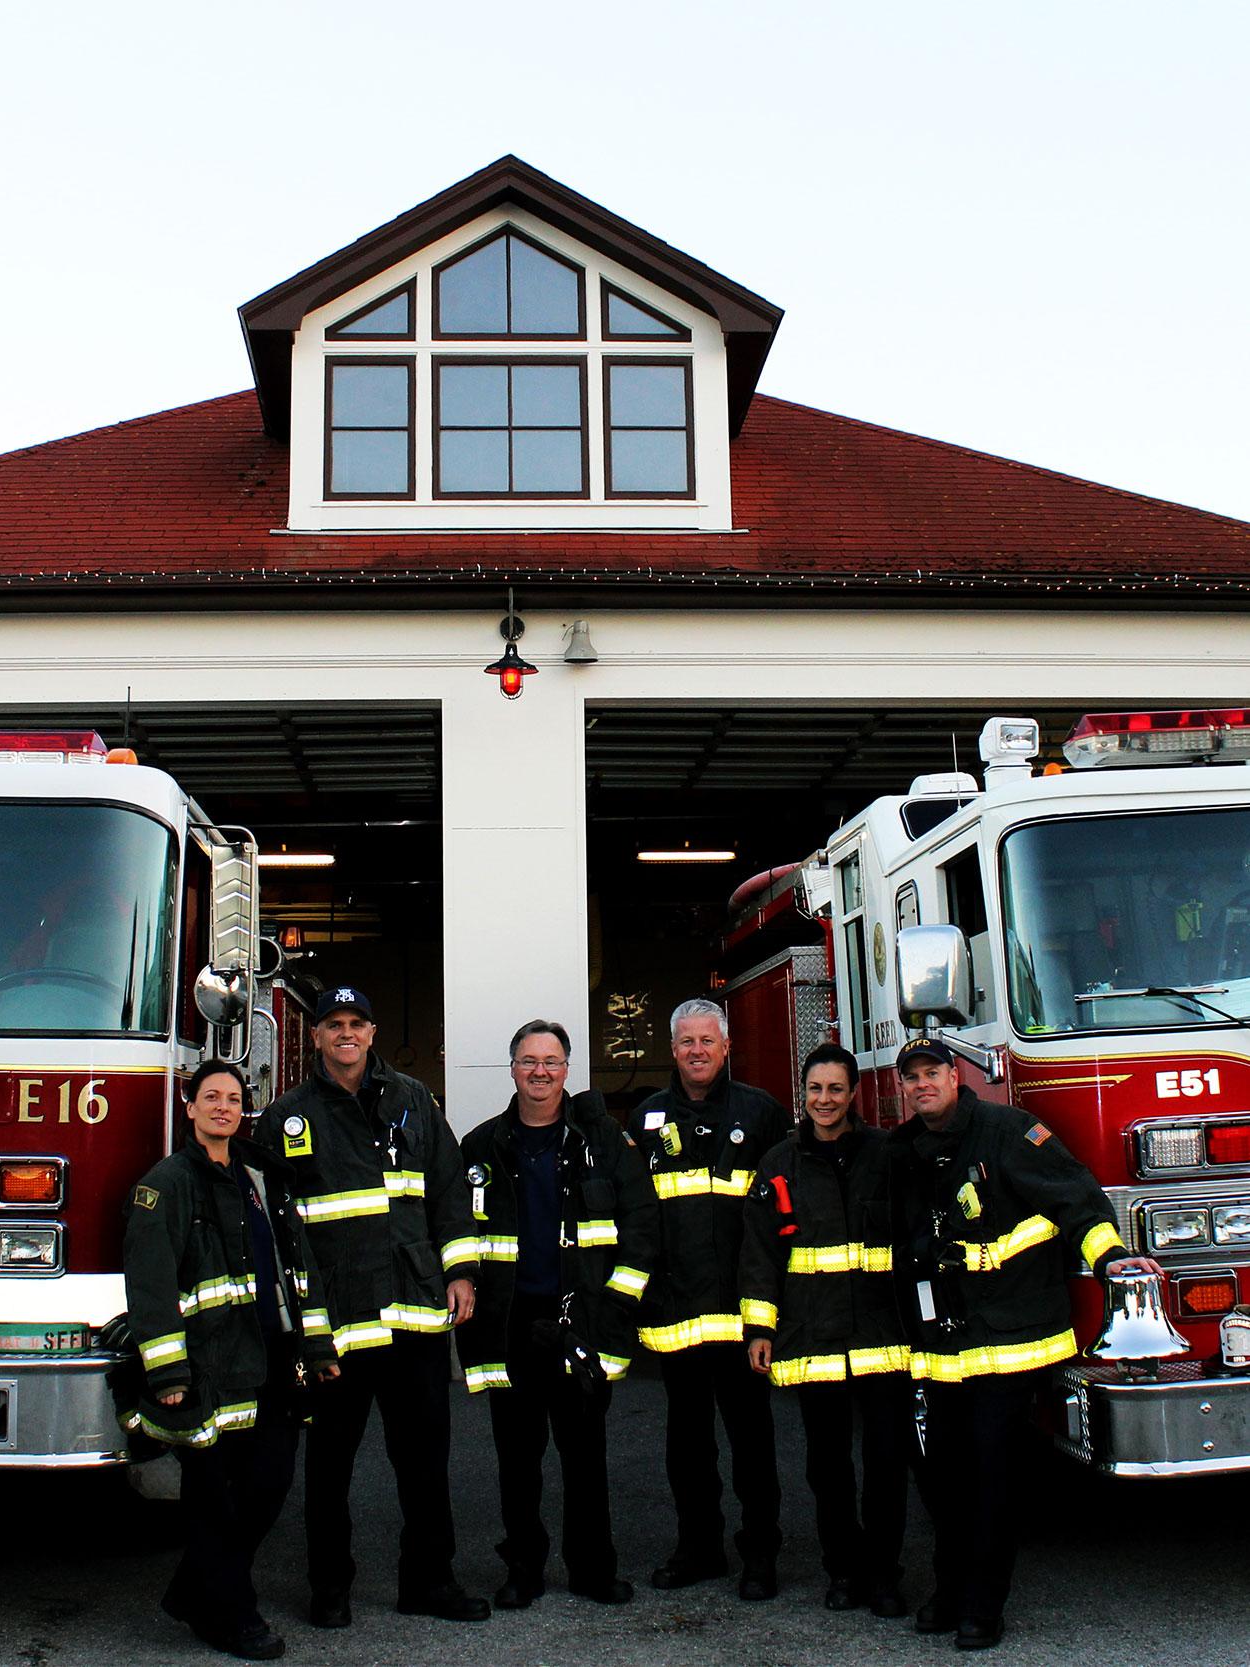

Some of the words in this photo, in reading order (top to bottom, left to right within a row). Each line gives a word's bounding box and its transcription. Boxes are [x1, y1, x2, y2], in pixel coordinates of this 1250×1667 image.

[17, 1079, 44, 1123] E
[58, 1079, 109, 1125] 16
[1155, 1068, 1221, 1099] E51
